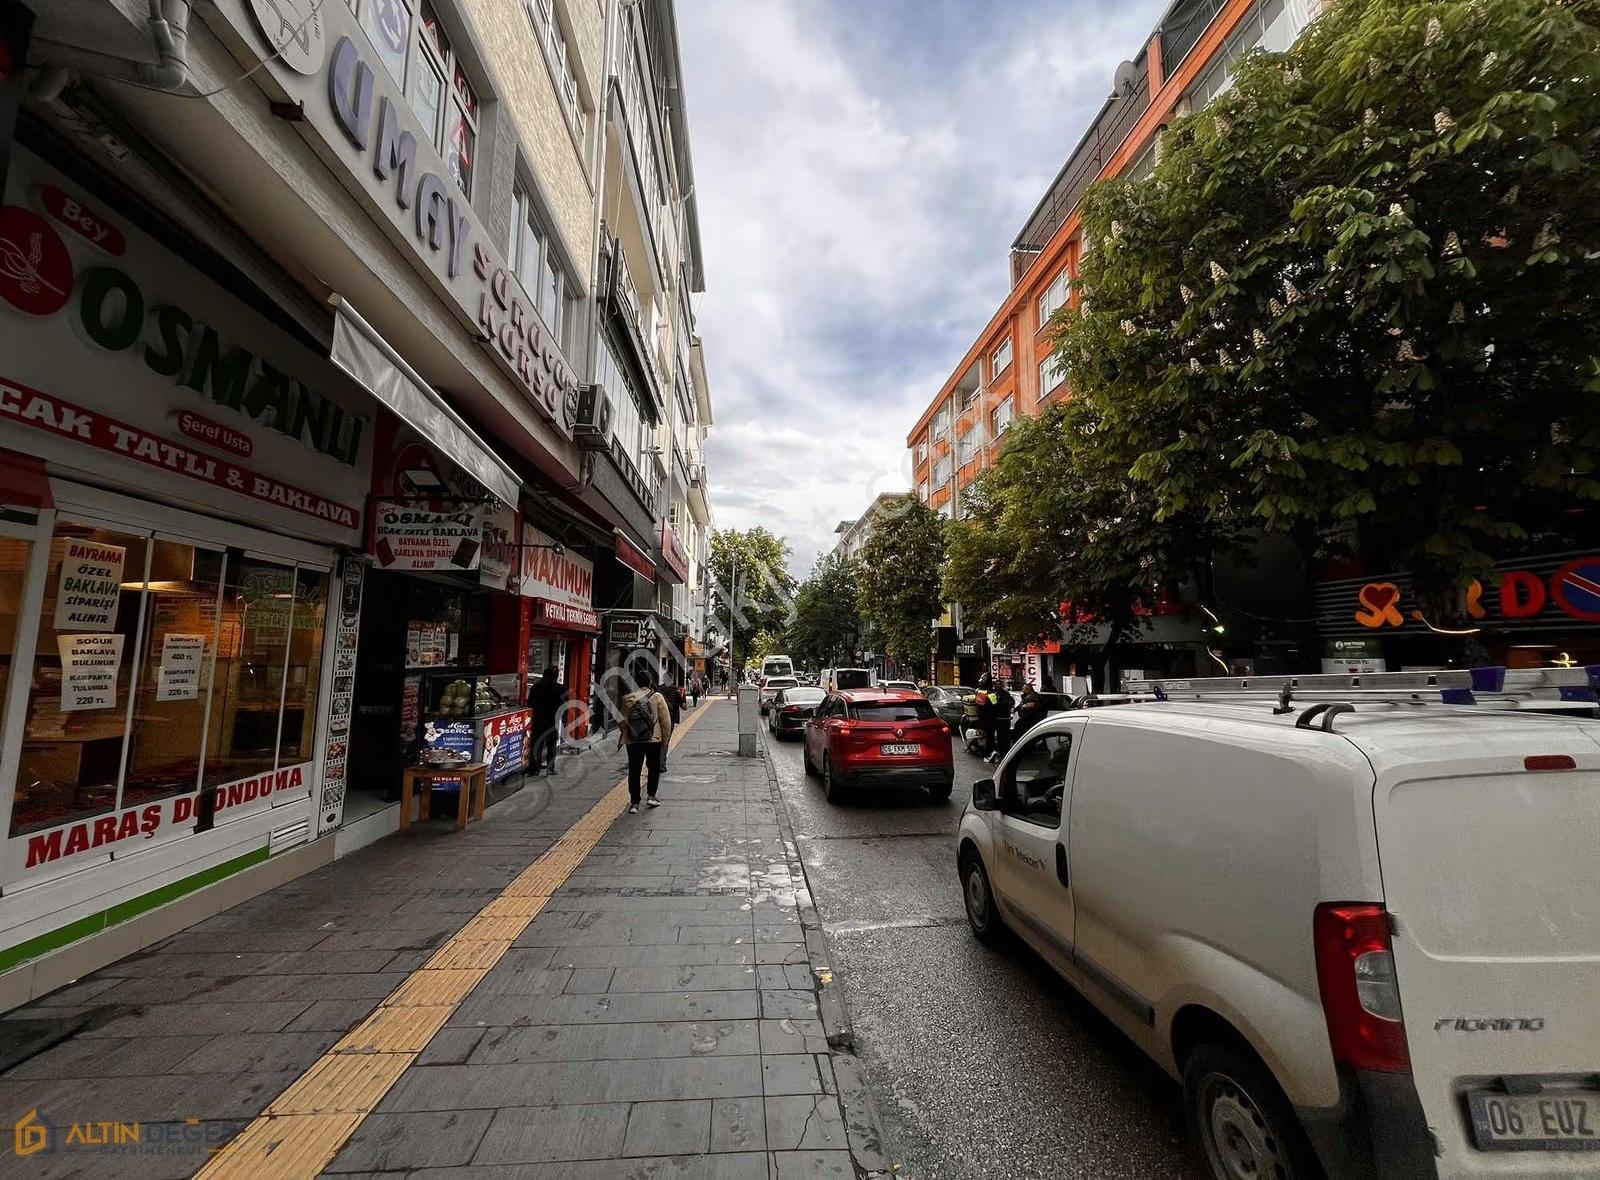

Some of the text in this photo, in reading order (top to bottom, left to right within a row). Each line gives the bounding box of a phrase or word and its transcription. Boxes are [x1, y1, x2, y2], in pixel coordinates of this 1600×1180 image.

[328, 36, 470, 278] UMAY
[62, 196, 109, 244] Bey
[80, 266, 366, 467] OSMANLI
[479, 293, 556, 412] KURSU
[181, 415, 251, 455] Şeref Usta
[109, 424, 217, 481] TATLI
[226, 467, 245, 490] &
[253, 472, 354, 526] BAKLAVA
[433, 527, 478, 536] BAKLAVA
[69, 545, 122, 564] BAYRAMA
[78, 564, 112, 577] ÖZEL
[523, 547, 592, 600] MAXIMUM
[64, 577, 118, 596] BAKLAVA
[65, 596, 114, 609] SİPARİŞİ
[69, 613, 108, 624] ALINIR
[76, 696, 94, 705] 220
[25, 804, 161, 868] MARAŞ
[1488, 1100, 1524, 1135] 06
[1539, 1100, 1594, 1136] EUZ
